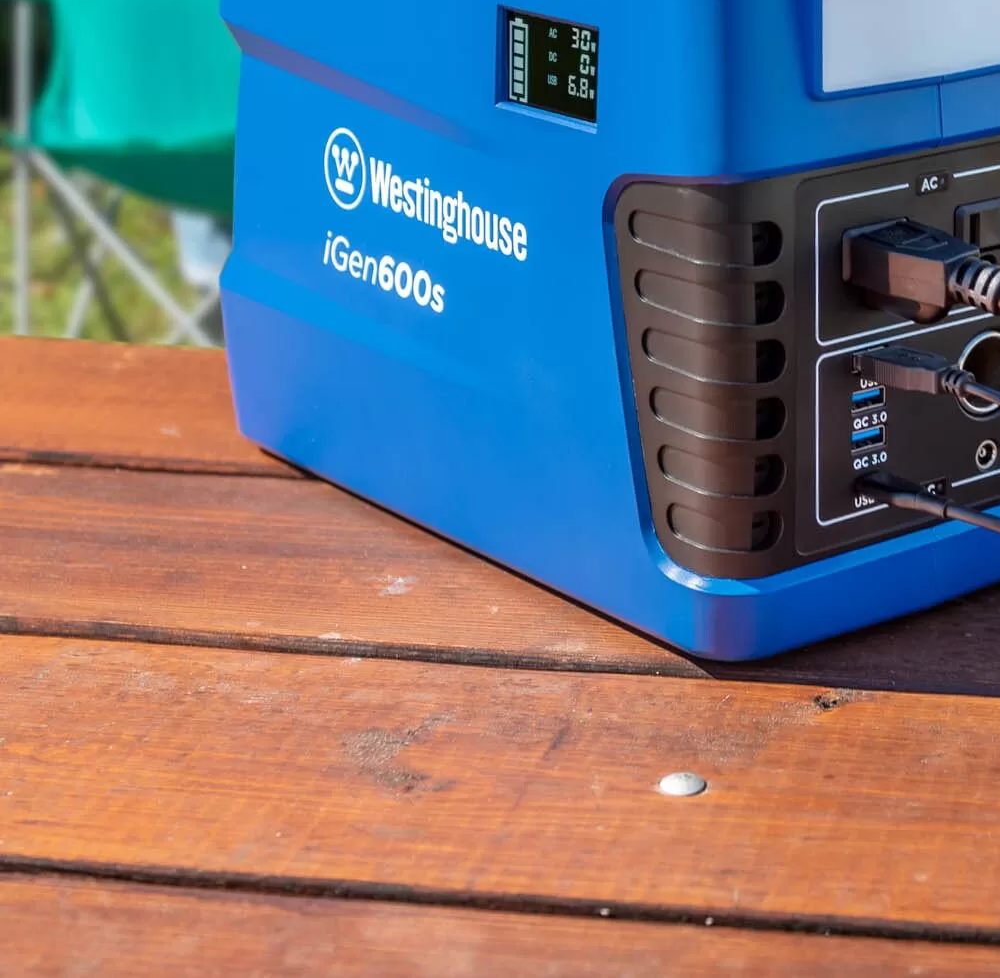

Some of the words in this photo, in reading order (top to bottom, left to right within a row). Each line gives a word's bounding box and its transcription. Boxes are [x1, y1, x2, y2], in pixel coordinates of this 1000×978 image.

[920, 175, 939, 193] AC
[369, 156, 528, 262] Westinghouse
[323, 230, 446, 314] iGen600s
[853, 416, 869, 430] QC
[871, 410, 888, 425] 3.0
[853, 455, 869, 471] QC
[871, 450, 888, 465] 3.0
